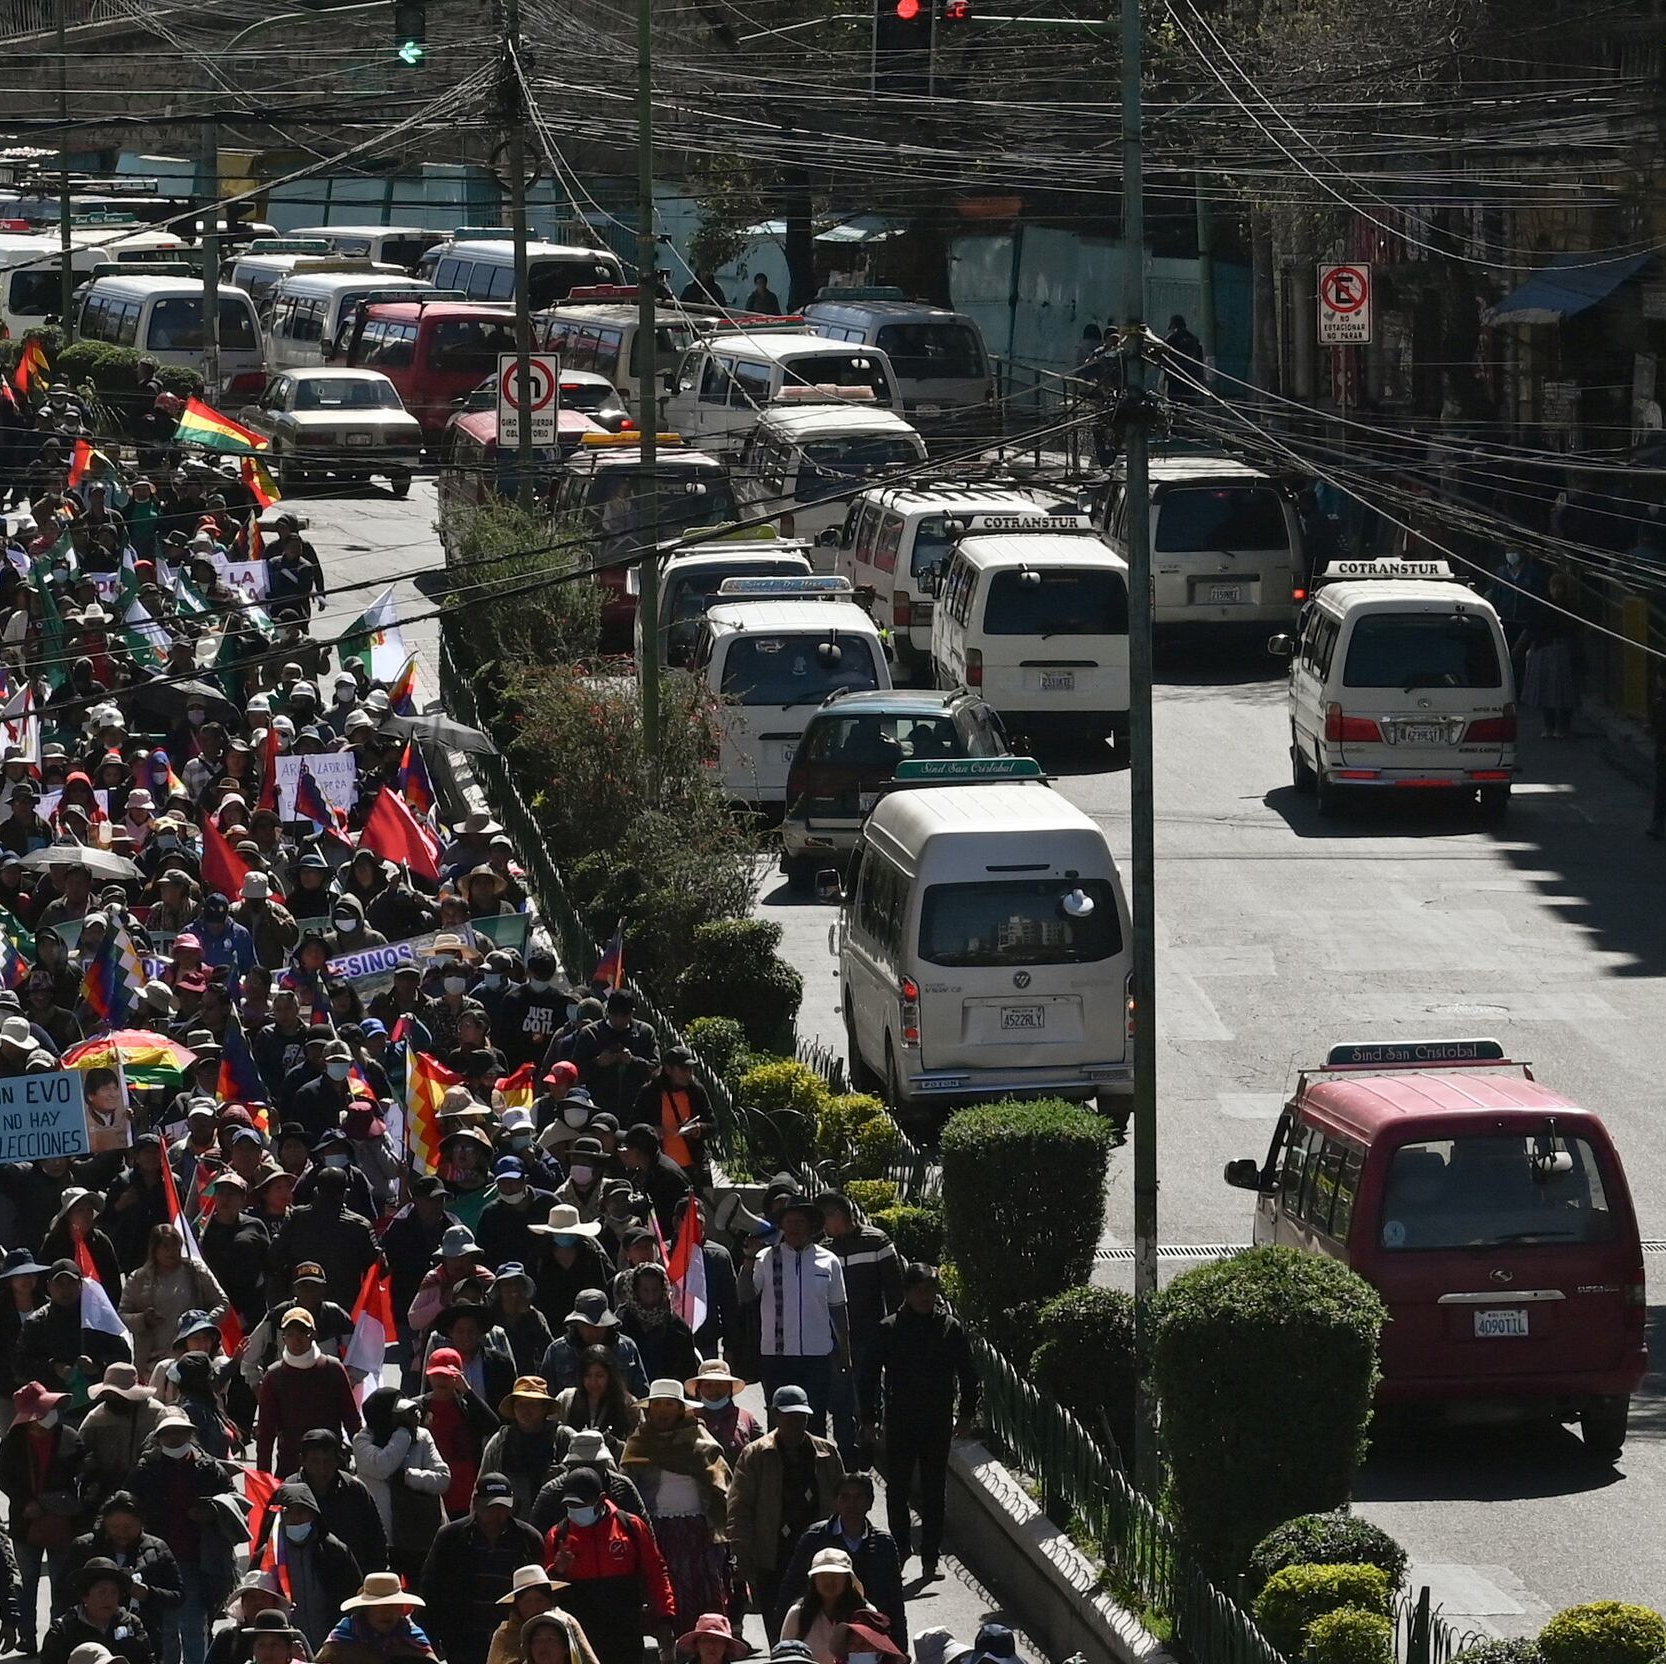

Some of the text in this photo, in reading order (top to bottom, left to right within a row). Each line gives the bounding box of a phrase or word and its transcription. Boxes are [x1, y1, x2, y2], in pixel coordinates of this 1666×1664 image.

[983, 516, 1079, 529] COTRANSTUR
[1338, 563, 1439, 574] COTRANSTUR
[527, 1005, 554, 1021] JUST
[522, 1017, 541, 1033] DO
[1351, 1043, 1477, 1062] Sind San Cristobal
[25, 1077, 71, 1104] EVO
[2, 1110, 61, 1131] NO HAY
